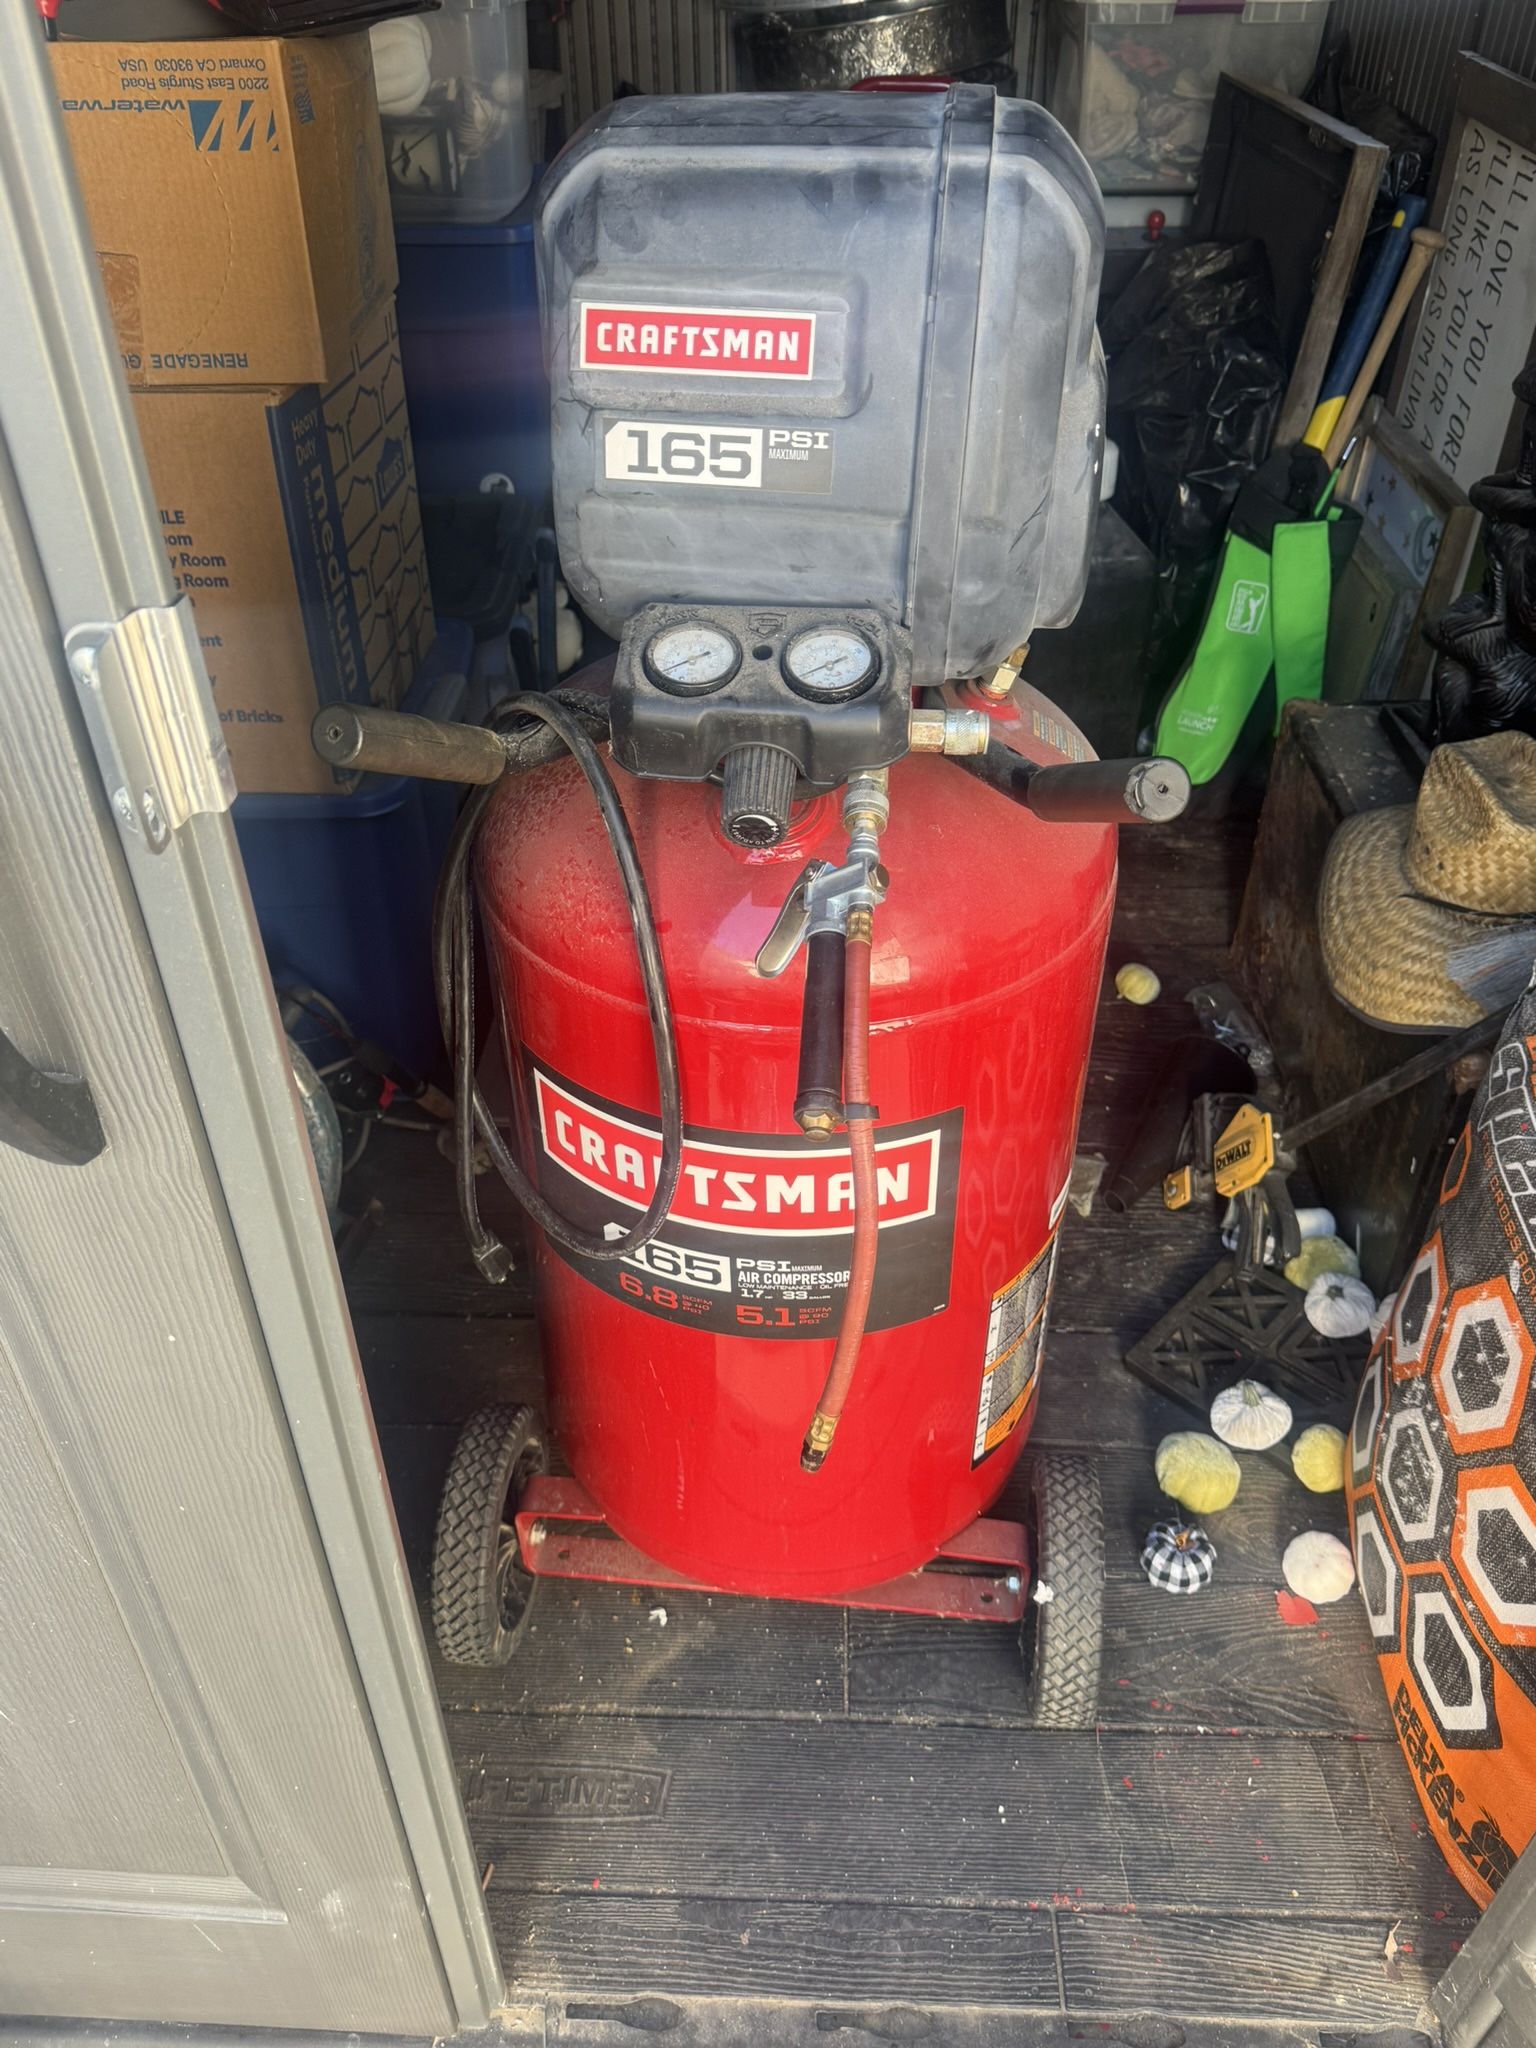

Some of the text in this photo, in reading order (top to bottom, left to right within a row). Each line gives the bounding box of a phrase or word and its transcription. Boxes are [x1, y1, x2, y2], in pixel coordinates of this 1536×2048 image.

[118, 58, 266, 71] Oxnard CA 93030 USA
[121, 75, 269, 90] 2200 East Sturgis Road
[62, 99, 186, 112] waterwa
[1466, 129, 1486, 176] AS
[1444, 186, 1475, 266] LONG
[1483, 219, 1520, 305] LOVE
[1421, 139, 1512, 452] I'LL LIKE YOU FOR A
[1426, 276, 1448, 321] AS
[597, 322, 799, 361] CRAFTSMAN
[1419, 329, 1438, 362] I'M
[1463, 322, 1493, 386] YOU
[151, 353, 248, 368] RENEGADE
[295, 436, 317, 466] Duty
[627, 429, 829, 479] 165 PSI
[769, 448, 809, 461] MAXIMUM
[180, 552, 226, 567] Room
[183, 573, 229, 587] Room
[309, 465, 358, 692] medium
[555, 1109, 910, 1214] CRATSMAN
[736, 1258, 791, 1272] PSI
[738, 1270, 851, 1285] AIR COMPRESSOR
[619, 1271, 678, 1310] 6.8
[741, 1288, 764, 1299] 1.7
[782, 1291, 808, 1299] 33
[735, 1304, 795, 1327] 5.1
[1394, 1679, 1454, 1810] DELTA
